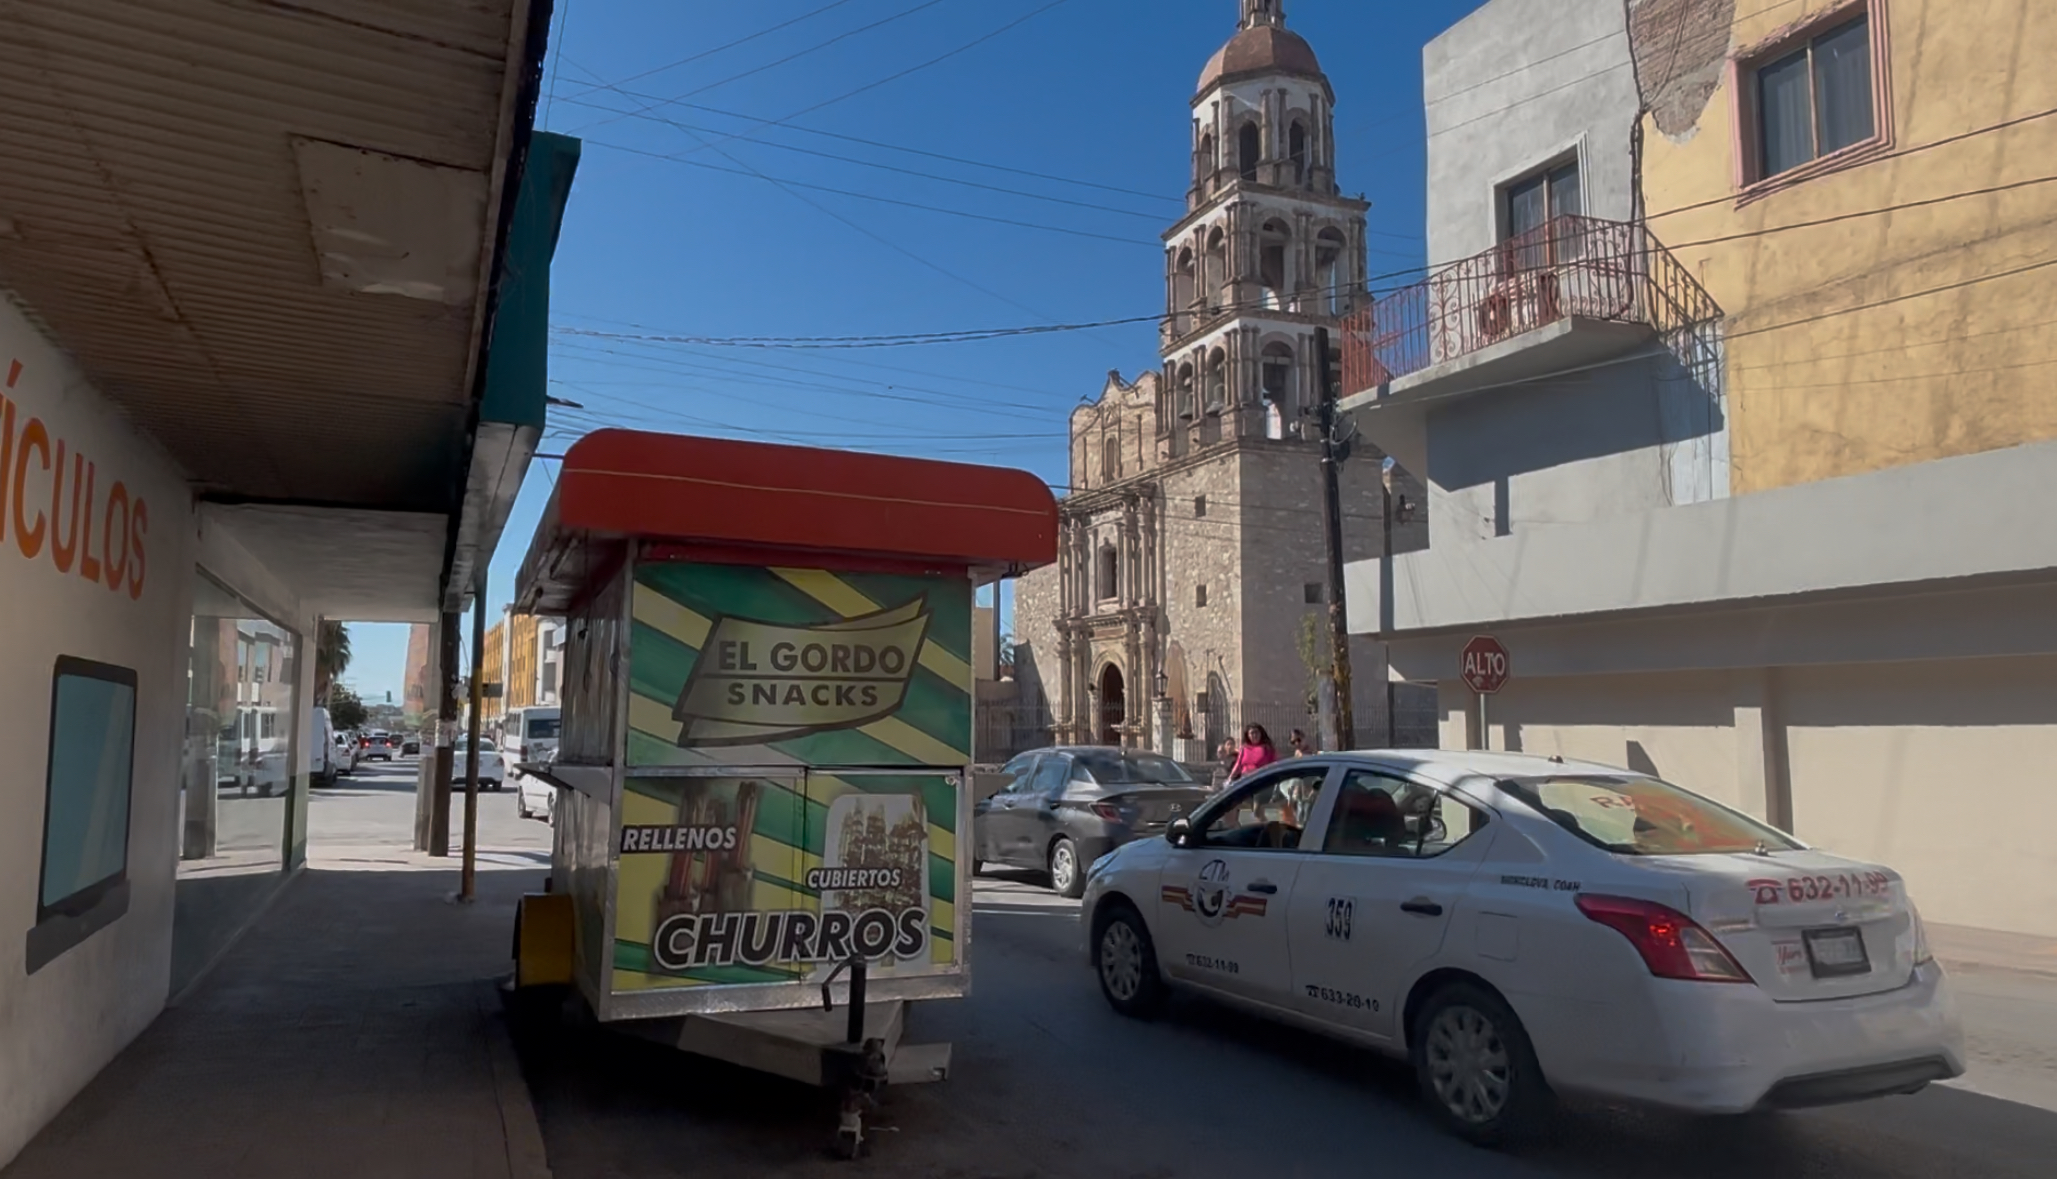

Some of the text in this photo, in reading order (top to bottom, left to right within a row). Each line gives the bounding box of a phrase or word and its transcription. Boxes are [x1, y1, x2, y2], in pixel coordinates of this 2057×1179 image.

[0, 358, 147, 600] ÍCULOS
[718, 641, 905, 674] EL GORDO
[1464, 652, 1505, 676] ALTO
[727, 682, 878, 706] SNACKS
[622, 826, 737, 851] RELLENOS
[807, 867, 901, 888] CUBIERTOS
[1787, 871, 1888, 902] 632-11-99
[1326, 897, 1353, 940] 359
[654, 907, 928, 970] CHURROS
